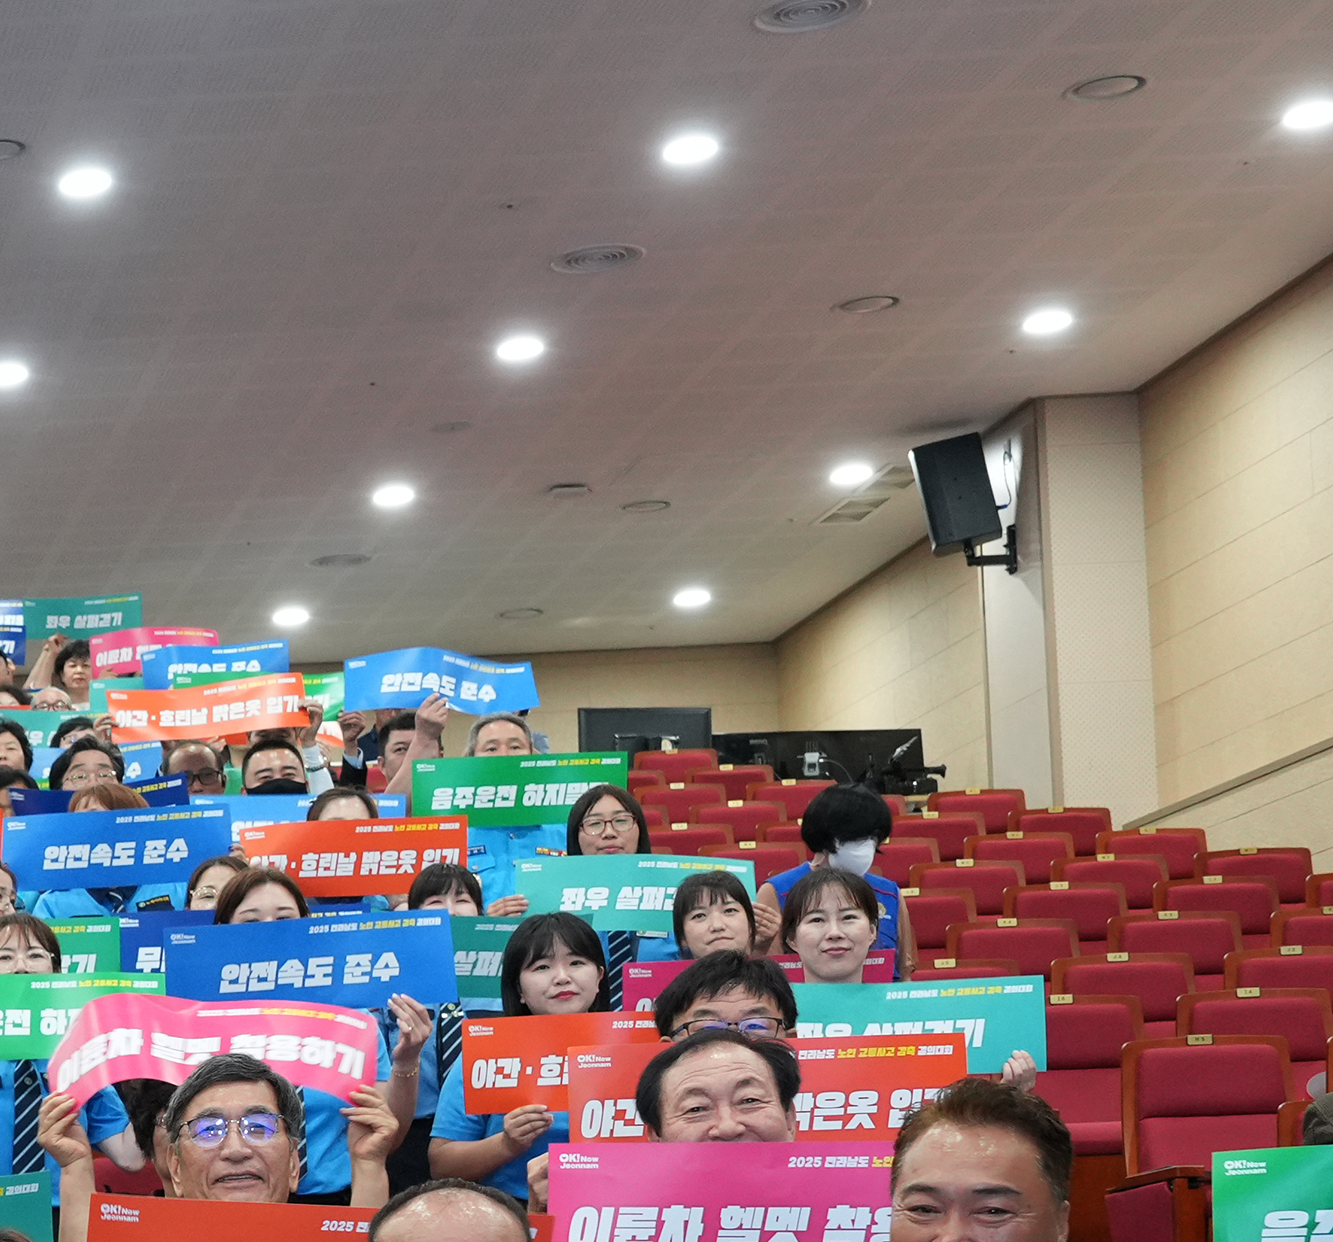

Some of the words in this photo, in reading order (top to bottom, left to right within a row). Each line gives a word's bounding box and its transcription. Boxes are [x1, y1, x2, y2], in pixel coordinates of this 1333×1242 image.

[459, 679, 496, 702] 준수
[115, 710, 147, 730] 야간
[159, 703, 209, 727] 흐린날
[212, 698, 261, 722] 밝은옷
[432, 783, 517, 809] 음주운전
[43, 842, 135, 870] 안전속도
[142, 838, 189, 864] 준수
[299, 851, 357, 876] 흐린날
[359, 849, 416, 874] 밝은옷
[559, 888, 609, 910] 좌우
[219, 956, 334, 994] 안전속도
[342, 952, 400, 985] 준수
[887, 991, 908, 999] 2025
[798, 1049, 835, 1059] 전라남도
[837, 1049, 856, 1058] 노인
[858, 1047, 895, 1057] 교통사고
[897, 1046, 915, 1056] 감축
[918, 1045, 953, 1055] 결의대회
[471, 1059, 520, 1089] 야간
[560, 1154, 582, 1165] OK!
[578, 1154, 599, 1165] Now
[560, 1160, 599, 1168] Jeonnam
[788, 1157, 822, 1167] 2025
[825, 1156, 869, 1167] 전라남도
[321, 1220, 354, 1231] 2025
